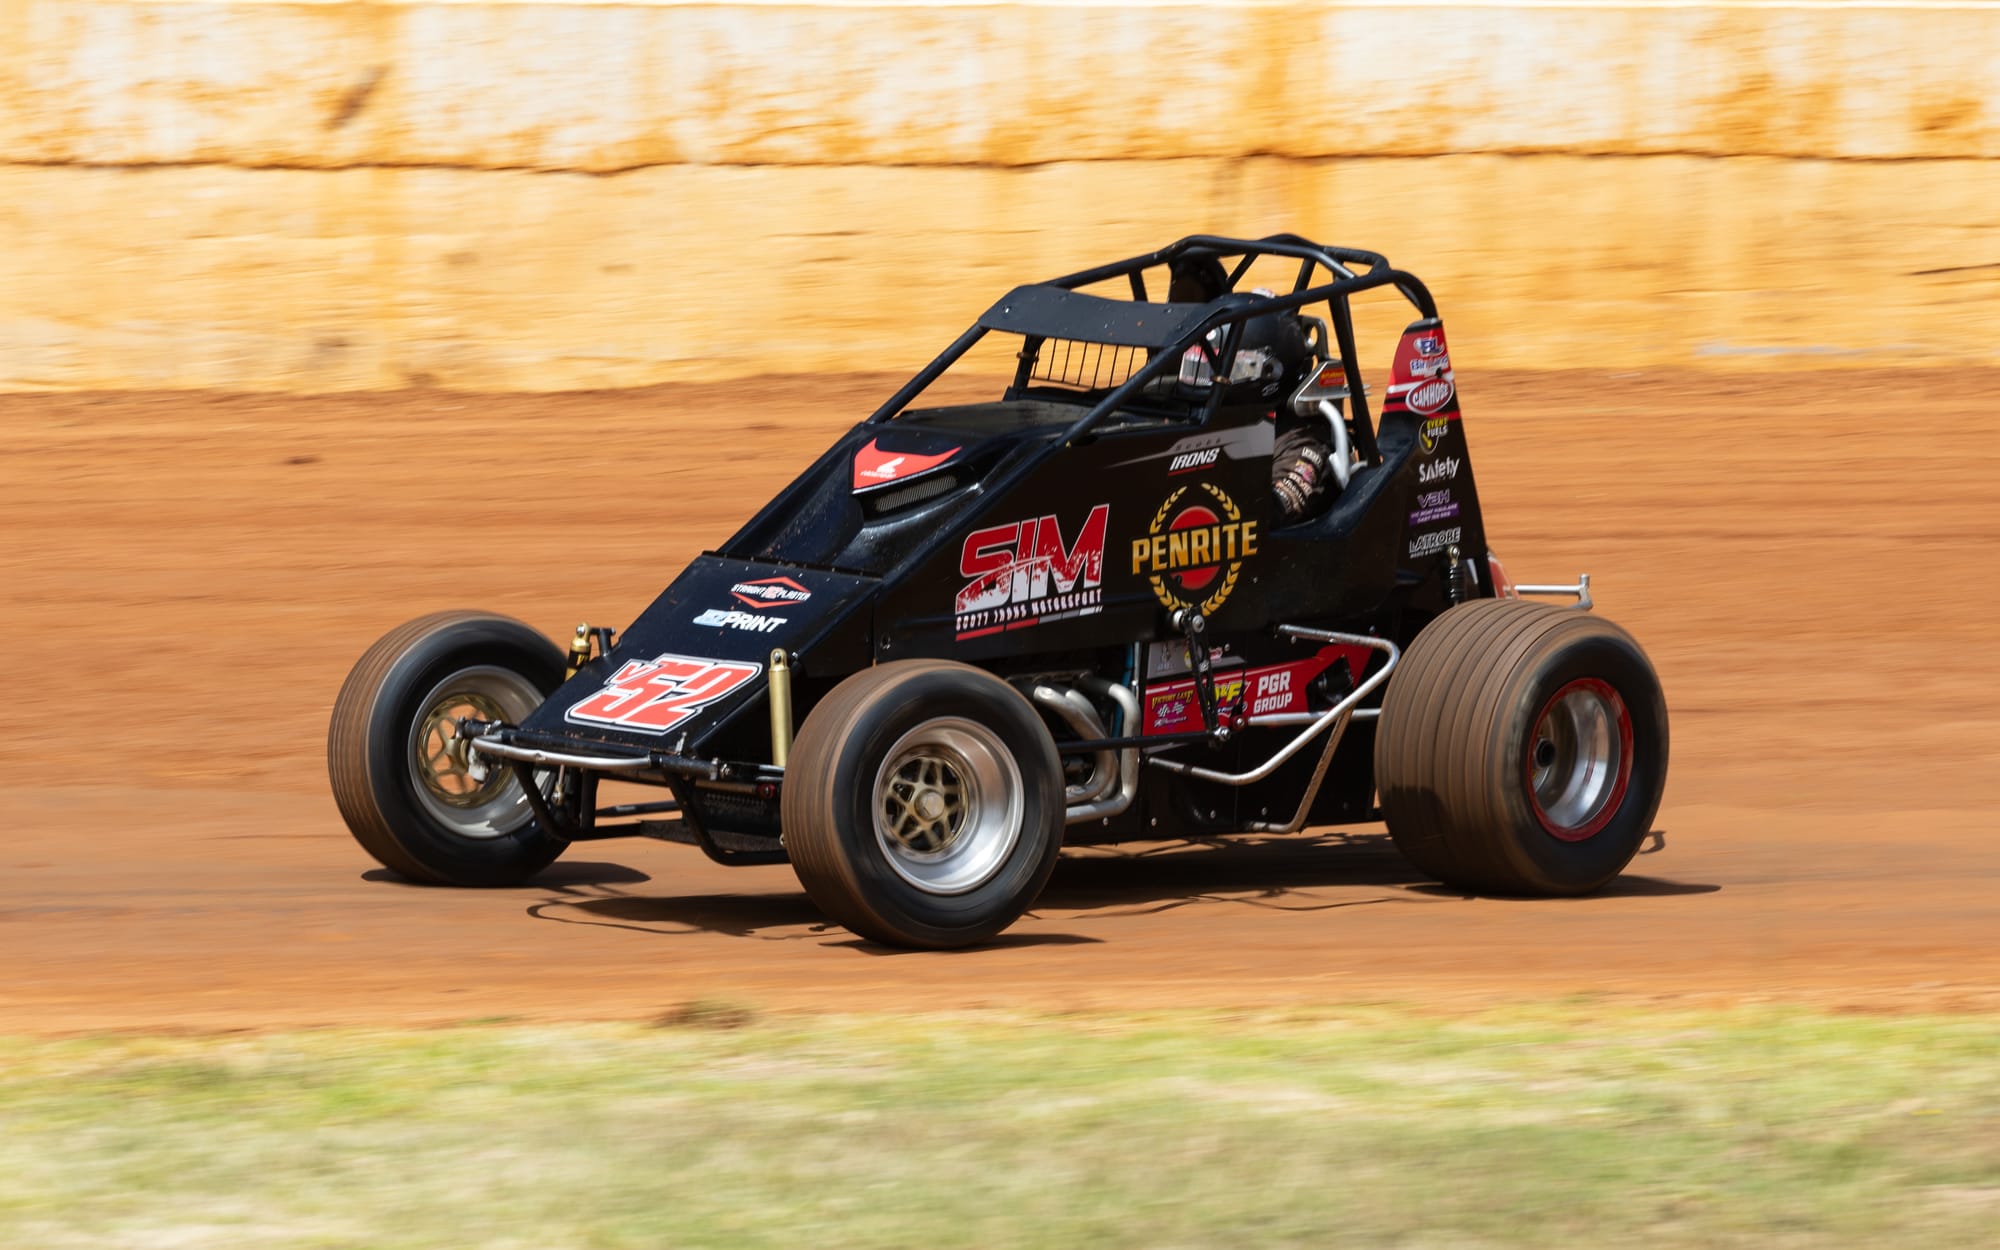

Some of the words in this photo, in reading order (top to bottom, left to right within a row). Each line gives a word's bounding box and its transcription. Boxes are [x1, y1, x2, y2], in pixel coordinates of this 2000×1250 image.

[1426, 416, 1448, 429] EVENT
[1427, 425, 1448, 438] FUELS
[1169, 447, 1220, 471] IRONS
[1132, 520, 1258, 575] PENRITE
[1409, 527, 1461, 553] LATROBE
[955, 503, 1110, 615] SIM
[956, 611, 989, 631] SCOTT
[994, 604, 1027, 623] IRONS
[1031, 588, 1102, 615] MOTORSPORT
[1257, 671, 1291, 698] PGR
[1253, 692, 1293, 715] GROUP
